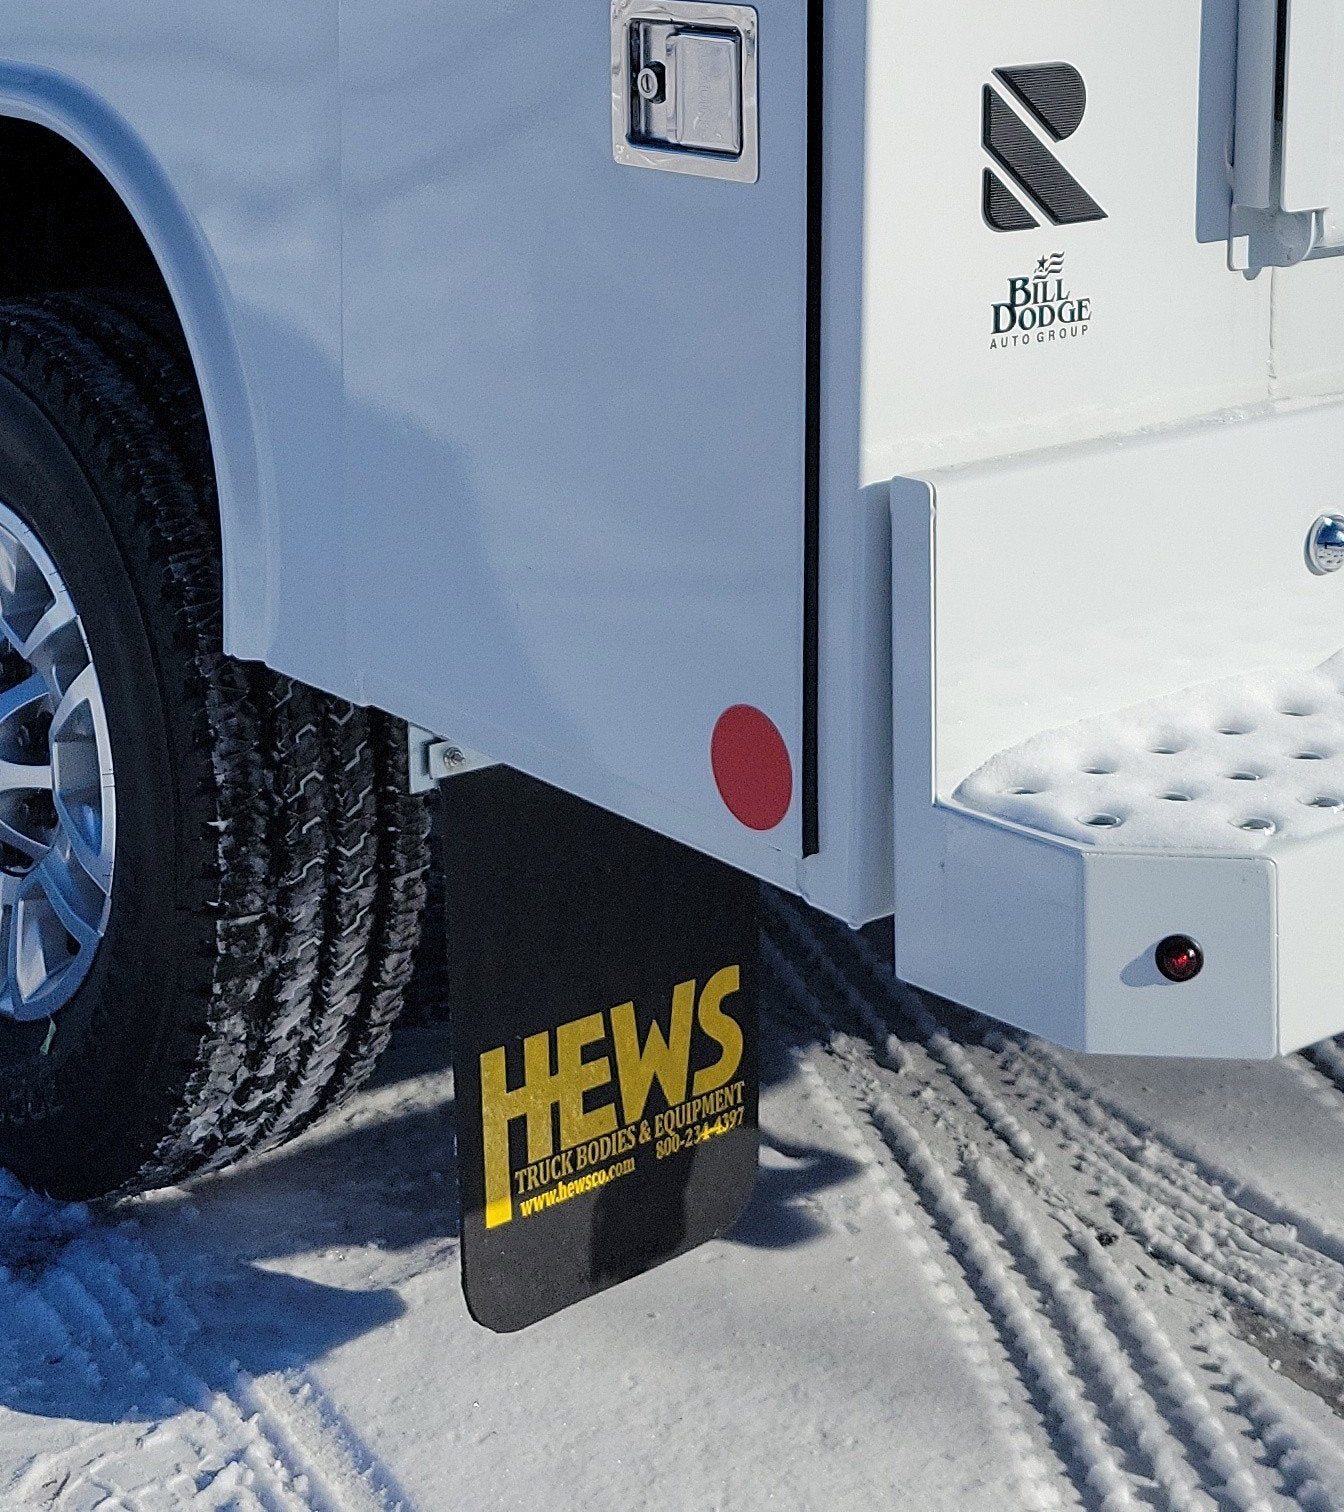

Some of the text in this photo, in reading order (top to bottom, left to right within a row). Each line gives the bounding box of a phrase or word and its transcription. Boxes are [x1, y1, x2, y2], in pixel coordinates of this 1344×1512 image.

[990, 297, 1093, 335] DODGE
[1007, 276, 1071, 308] BILL
[989, 324, 1090, 350] AUTO GROUP
[480, 964, 745, 1230] HEWS
[514, 1080, 746, 1196] TRUCK BODIES & EQUIPMENT
[655, 1105, 746, 1161] 800-234-4397
[519, 1157, 636, 1219] www.hewsco.com
